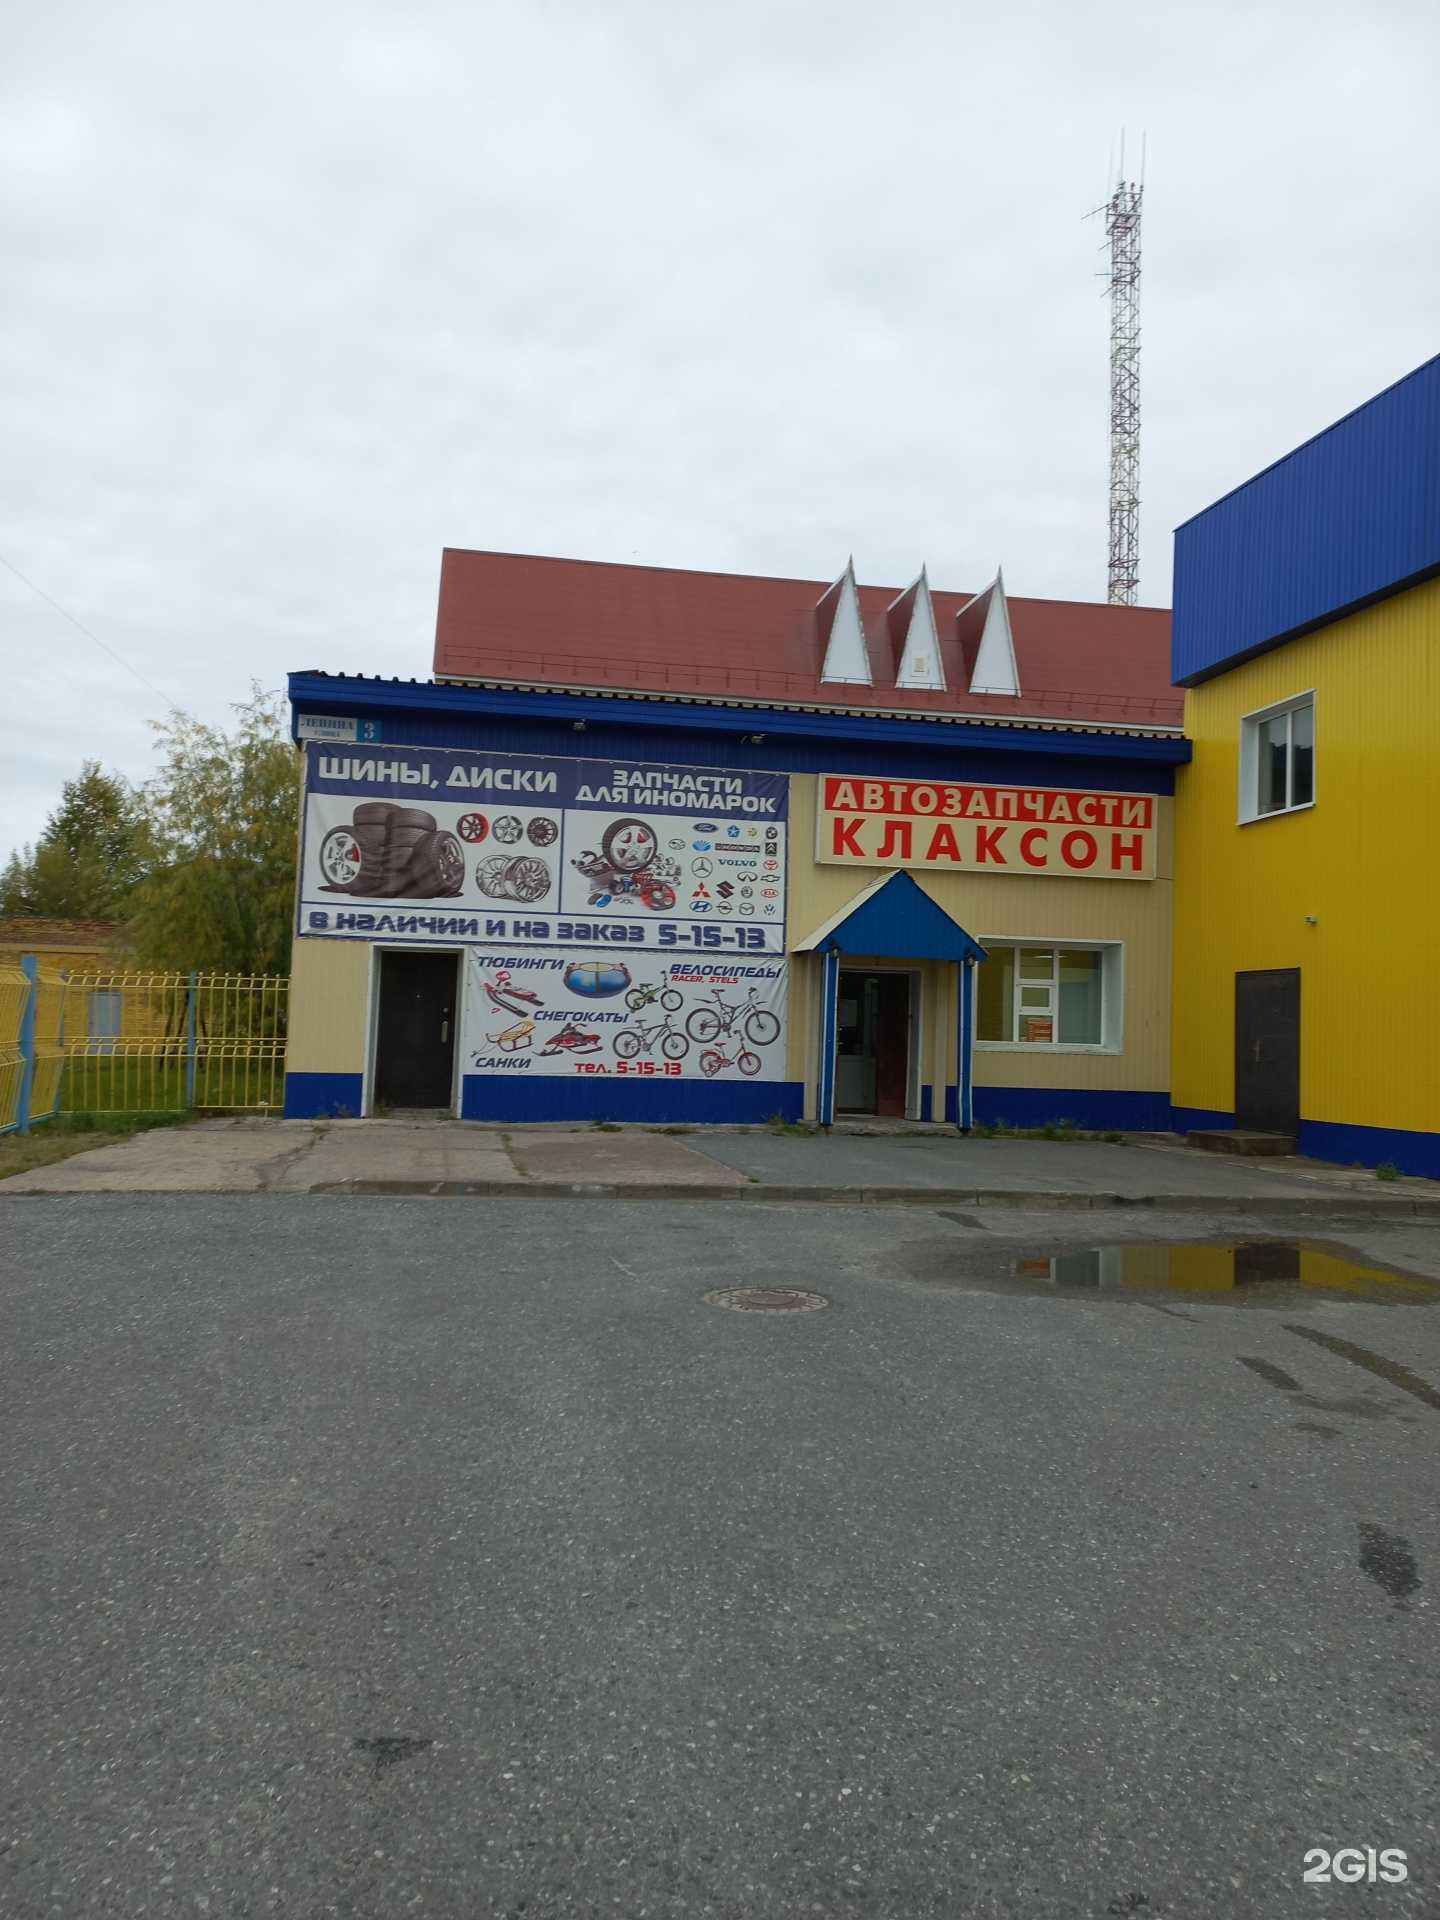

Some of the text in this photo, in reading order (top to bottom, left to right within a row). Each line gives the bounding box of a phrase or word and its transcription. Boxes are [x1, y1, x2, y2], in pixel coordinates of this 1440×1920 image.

[364, 721, 374, 739] 3
[319, 756, 557, 792] ШИНЫ, ДИСКИ
[613, 770, 742, 794] ЗАПЧАСТИ
[576, 785, 776, 812] ДЛЯ ИНОМАРОК
[832, 782, 1145, 827] АВТОЗАПЧАСТИ
[833, 818, 1142, 871] КЛАКСОН
[718, 859, 757, 867] VOLVO
[336, 912, 478, 935] наличии
[486, 919, 505, 936] и
[513, 920, 550, 939] на
[557, 922, 645, 942] заказ
[658, 924, 766, 949] 5-15-13
[478, 956, 565, 971] ТЮБИНГИ
[669, 963, 782, 978] ВЕЛОСИПЕДЫ
[708, 976, 739, 984] STELS
[533, 1010, 629, 1024] СНЕГОКАТЫ
[475, 1057, 531, 1069] САНКИ
[574, 1061, 682, 1075] тел. 5-15-13
